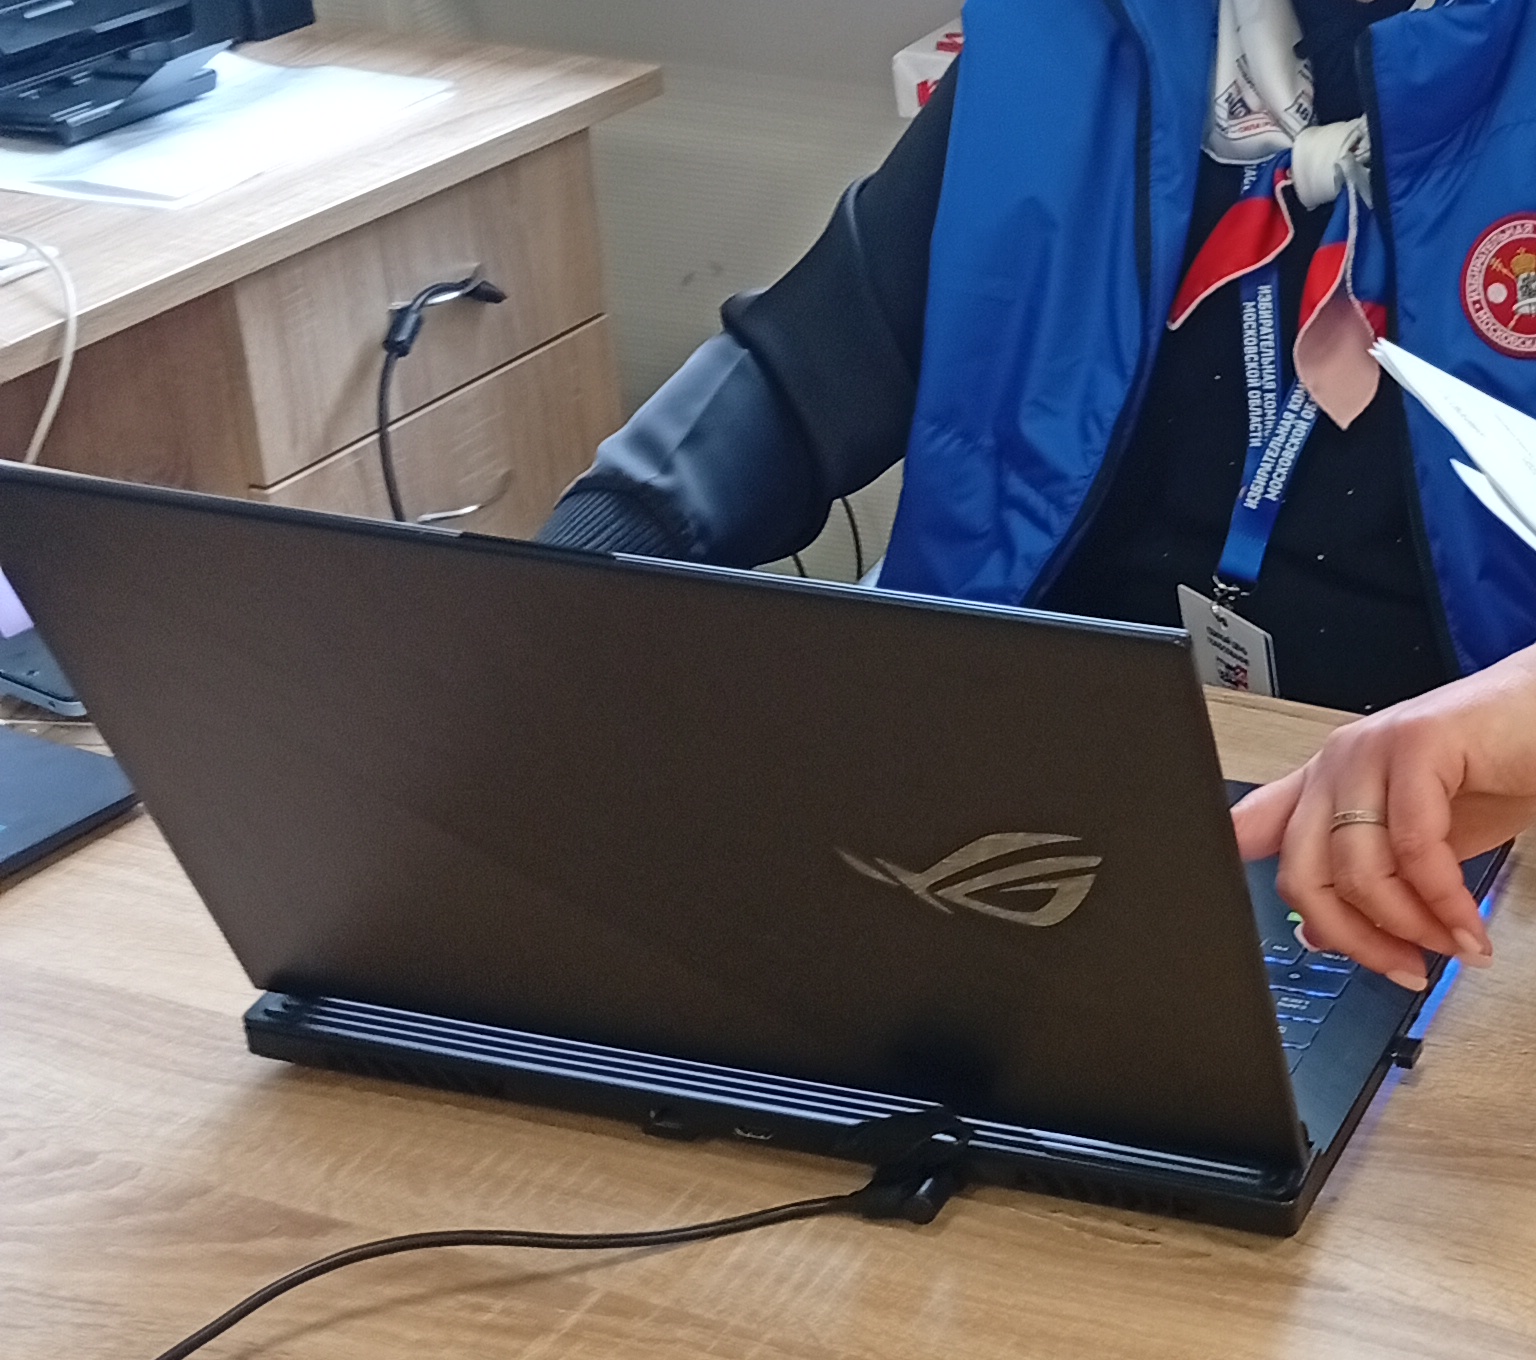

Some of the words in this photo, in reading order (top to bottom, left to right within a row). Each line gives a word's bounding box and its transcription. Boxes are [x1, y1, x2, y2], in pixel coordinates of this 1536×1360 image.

[1468, 223, 1534, 300] ИЗБИРАТЕЛЬНАЯ
[1242, 301, 1261, 388] МОСКОВСКОЙ
[1257, 285, 1277, 390] ИЗБИРАТЕЛЬНАЯ
[1243, 411, 1297, 510] ИЗБИРАТЕЛЬНАЯ
[1248, 390, 1263, 447] ОБЛАСТИ
[1262, 419, 1311, 501] МОСКОВСКОЙ
